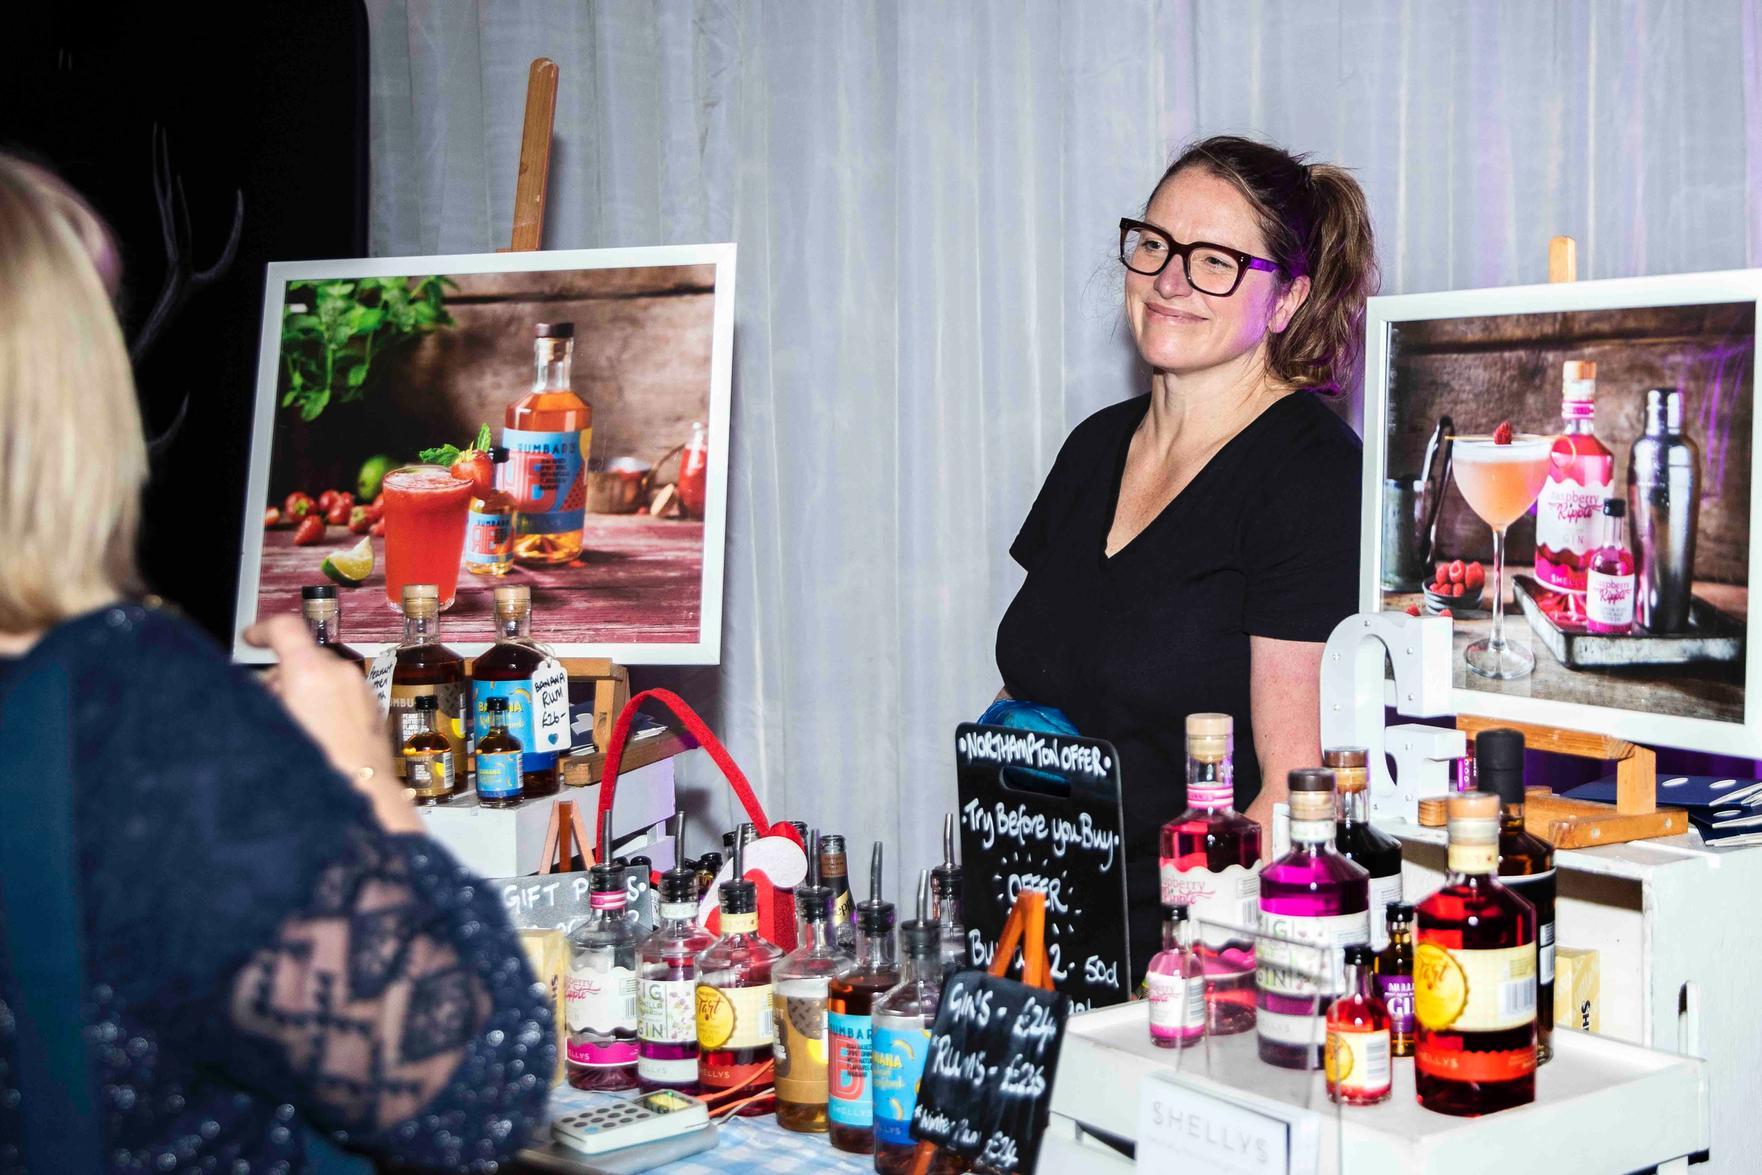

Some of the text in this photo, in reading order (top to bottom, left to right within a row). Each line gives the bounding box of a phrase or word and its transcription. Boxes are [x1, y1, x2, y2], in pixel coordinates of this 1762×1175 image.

[535, 672, 566, 693] BANANA
[541, 688, 564, 709] RUM
[1060, 744, 1107, 776] OFFER
[964, 798, 994, 849] Try
[995, 801, 1049, 846] Before
[1079, 812, 1114, 872] Buy
[503, 883, 560, 915] GIFT
[1386, 996, 1415, 1016] GI
[1151, 1101, 1271, 1164] SHELLYS
